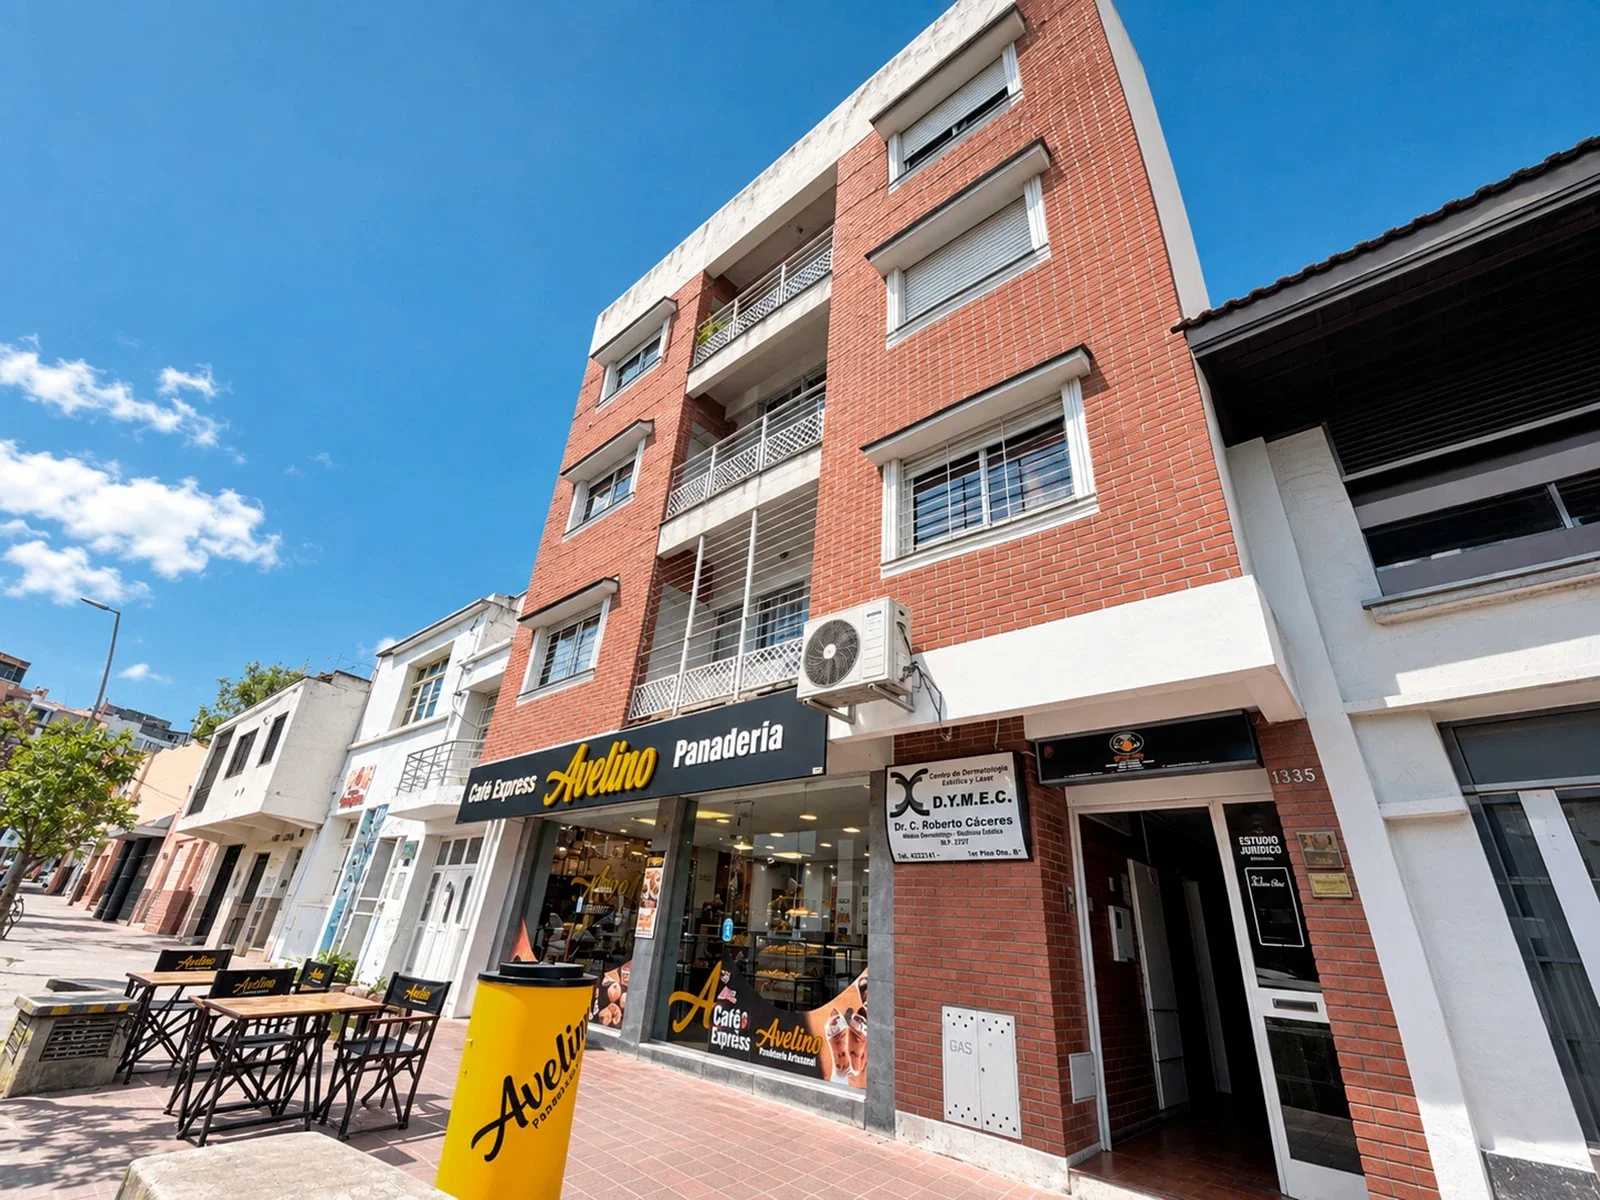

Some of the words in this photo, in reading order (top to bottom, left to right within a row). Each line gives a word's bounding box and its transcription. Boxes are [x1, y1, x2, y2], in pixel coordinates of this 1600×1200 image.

[543, 740, 657, 806] Avelino
[929, 771, 951, 780] Centro
[1272, 768, 1316, 784] 1335
[467, 781, 491, 803] Café
[493, 774, 538, 802] Express
[933, 790, 1012, 808] D.Y.M.E.C.
[894, 822, 908, 831] Dr.
[909, 821, 919, 831] C.
[922, 819, 963, 830] Roberto
[965, 816, 1013, 829] Cáceres
[1239, 836, 1279, 845] ESTUDIO
[755, 1018, 822, 1055] Avelino
